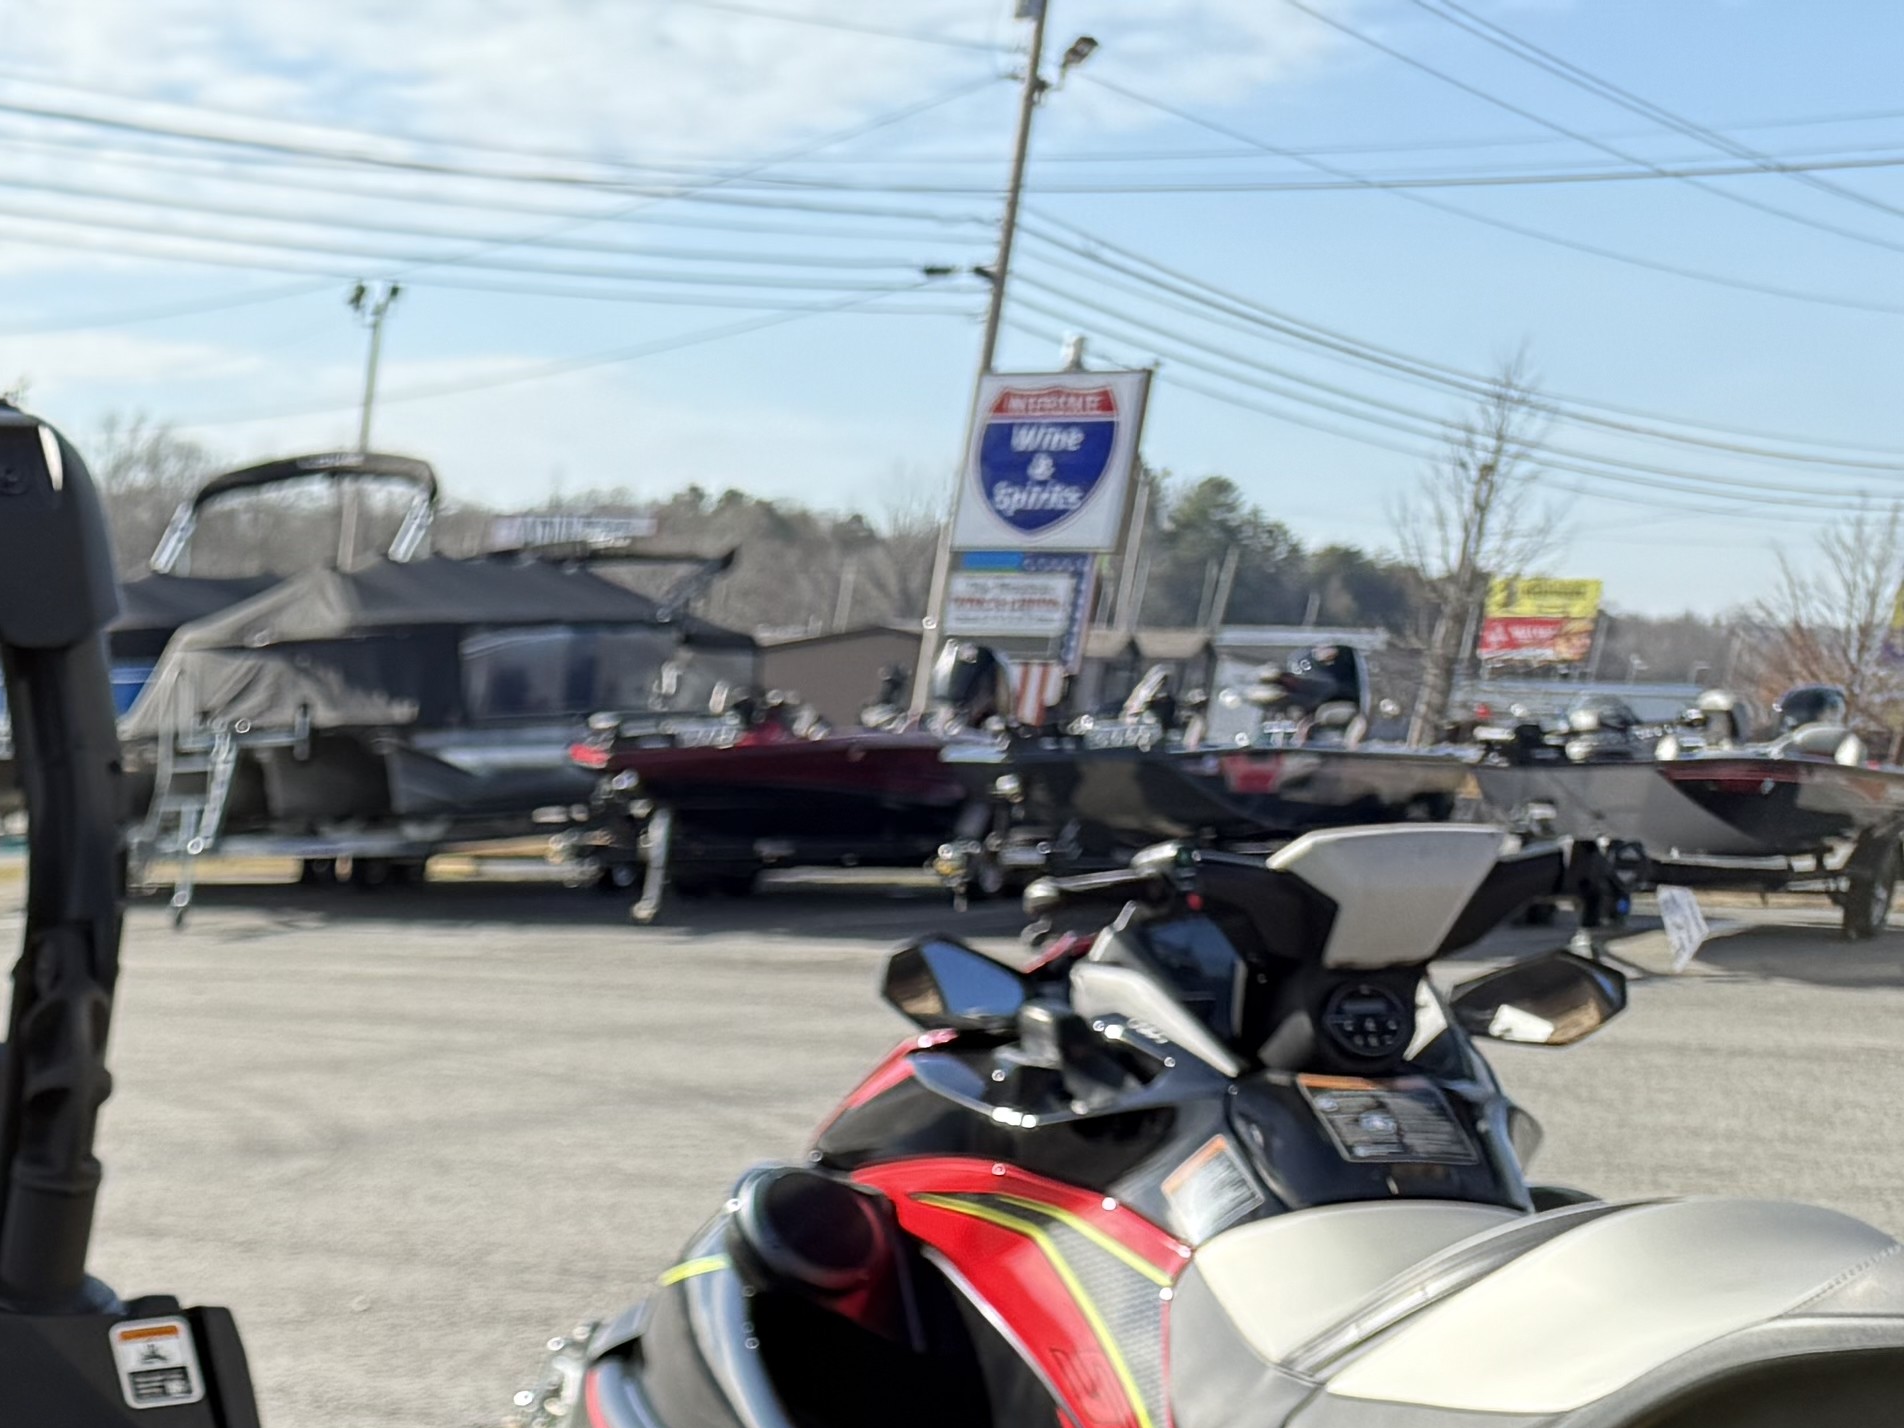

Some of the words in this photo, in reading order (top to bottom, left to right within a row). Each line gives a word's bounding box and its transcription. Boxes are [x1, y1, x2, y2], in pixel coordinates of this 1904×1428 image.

[1011, 424, 1086, 453] Wine
[1027, 452, 1056, 481] &
[993, 479, 1084, 516] Spirits
